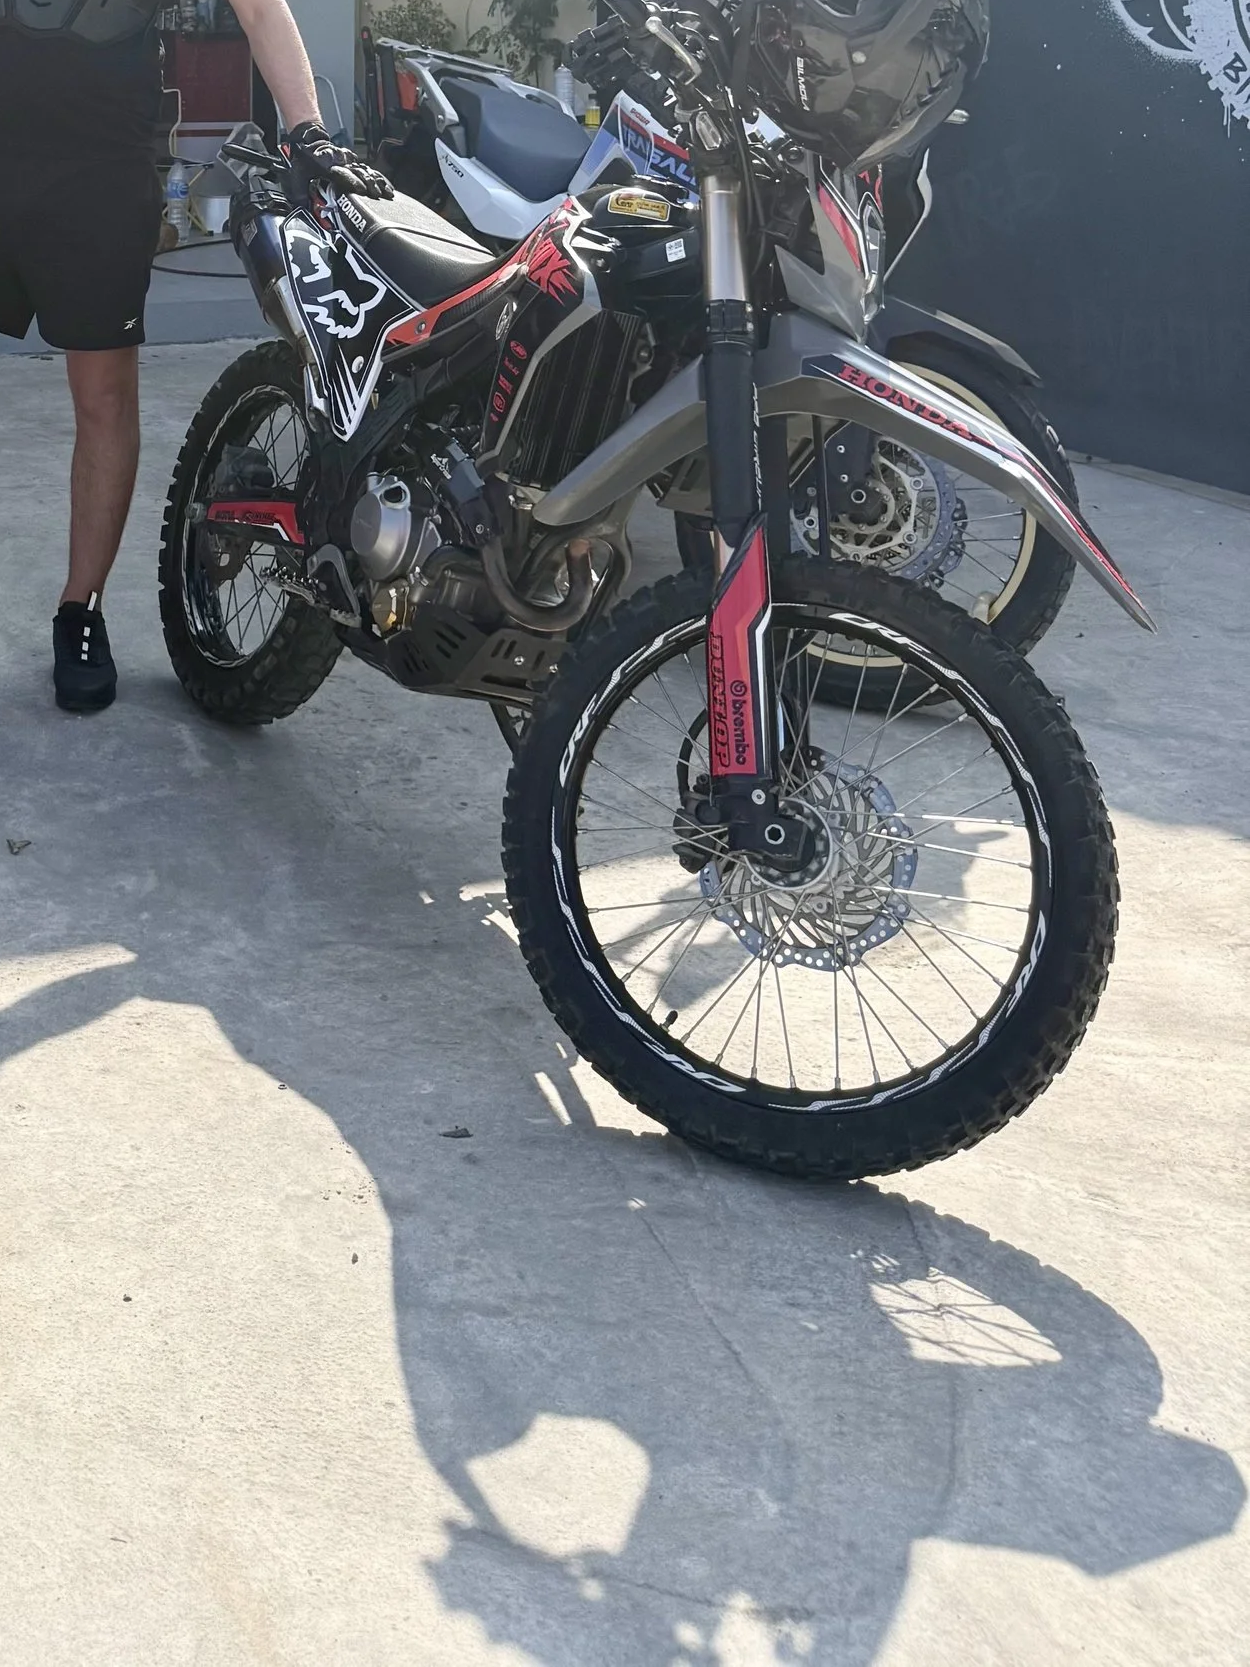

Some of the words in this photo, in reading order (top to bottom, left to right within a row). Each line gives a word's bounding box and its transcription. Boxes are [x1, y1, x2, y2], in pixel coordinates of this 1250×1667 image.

[336, 193, 368, 234] HONDA
[837, 363, 974, 443] HONDA
[827, 611, 932, 655] CRF
[709, 631, 731, 769] DUNLOP
[731, 698, 750, 767] brembo
[558, 693, 599, 788] CRF
[1005, 909, 1048, 1020] CRF
[642, 1039, 747, 1094] CRF
